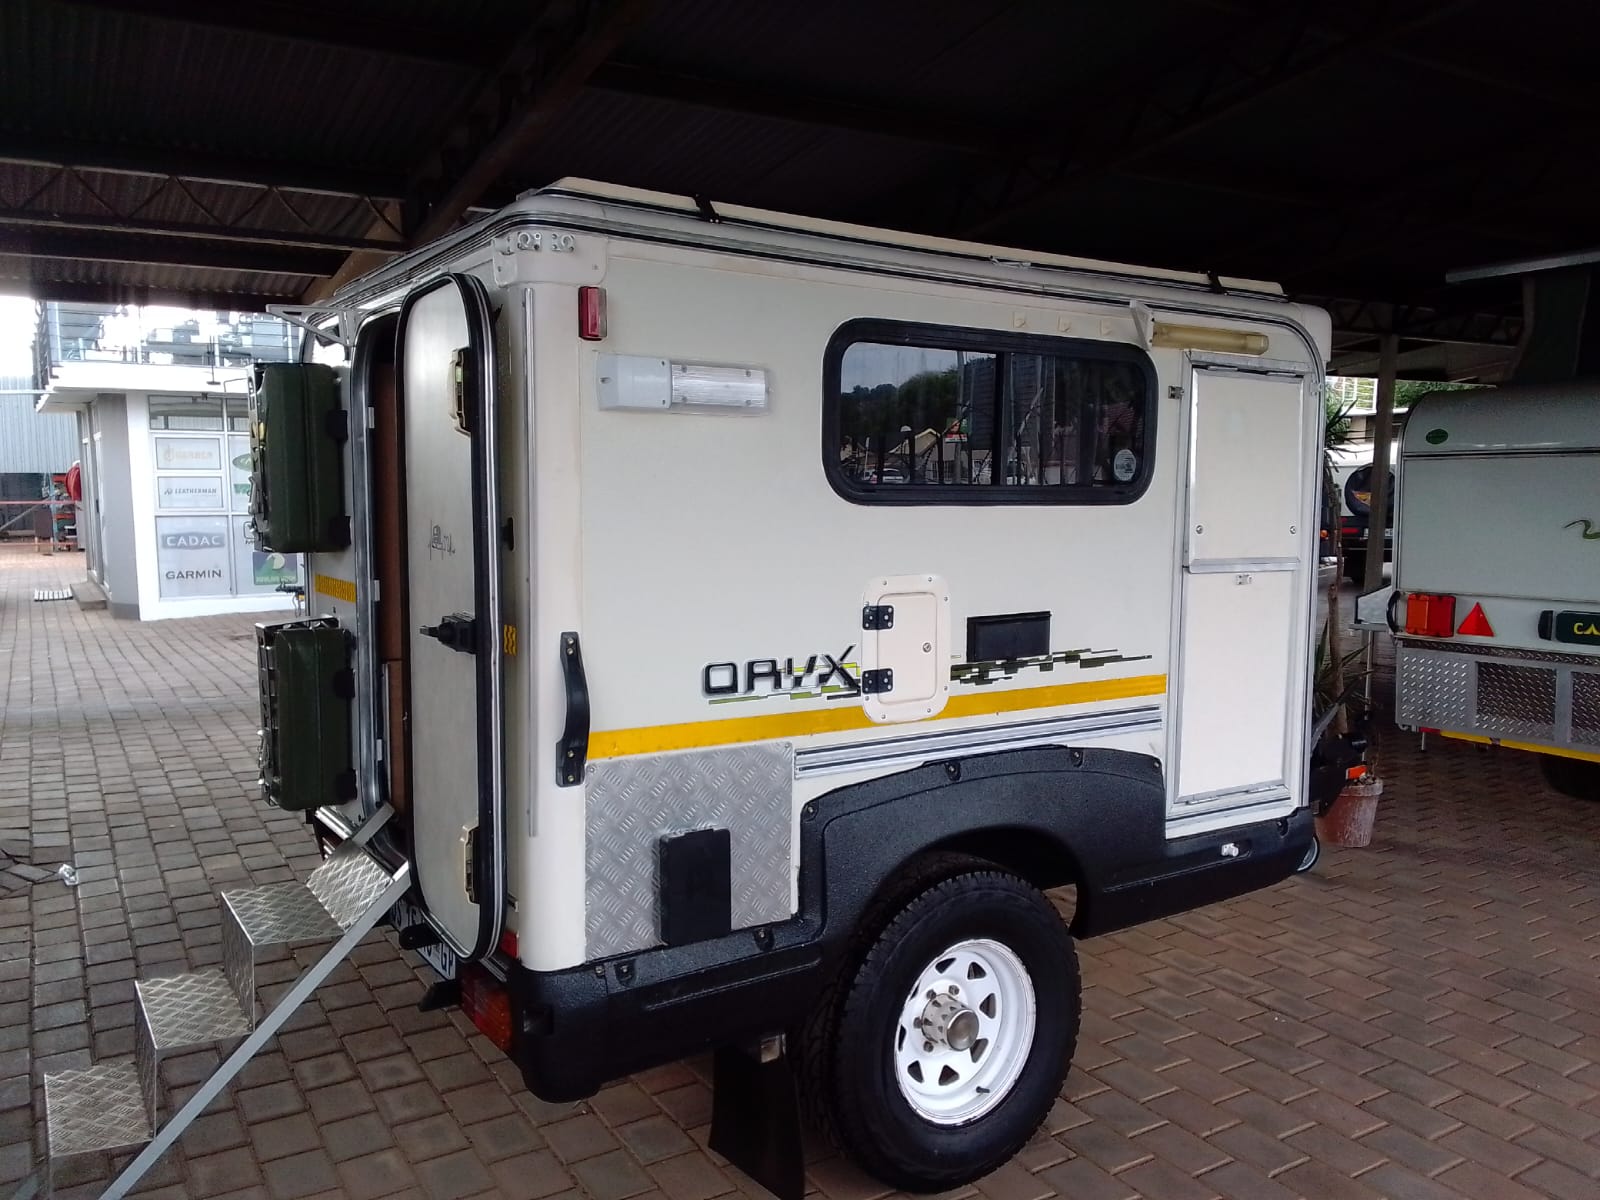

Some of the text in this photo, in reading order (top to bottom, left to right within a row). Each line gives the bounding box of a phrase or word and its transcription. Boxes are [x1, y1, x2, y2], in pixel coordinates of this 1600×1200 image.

[174, 487, 217, 495] LEATHERMAN
[166, 535, 221, 547] CADAC
[165, 569, 222, 580] GARMIN
[703, 644, 861, 695] ORYX
